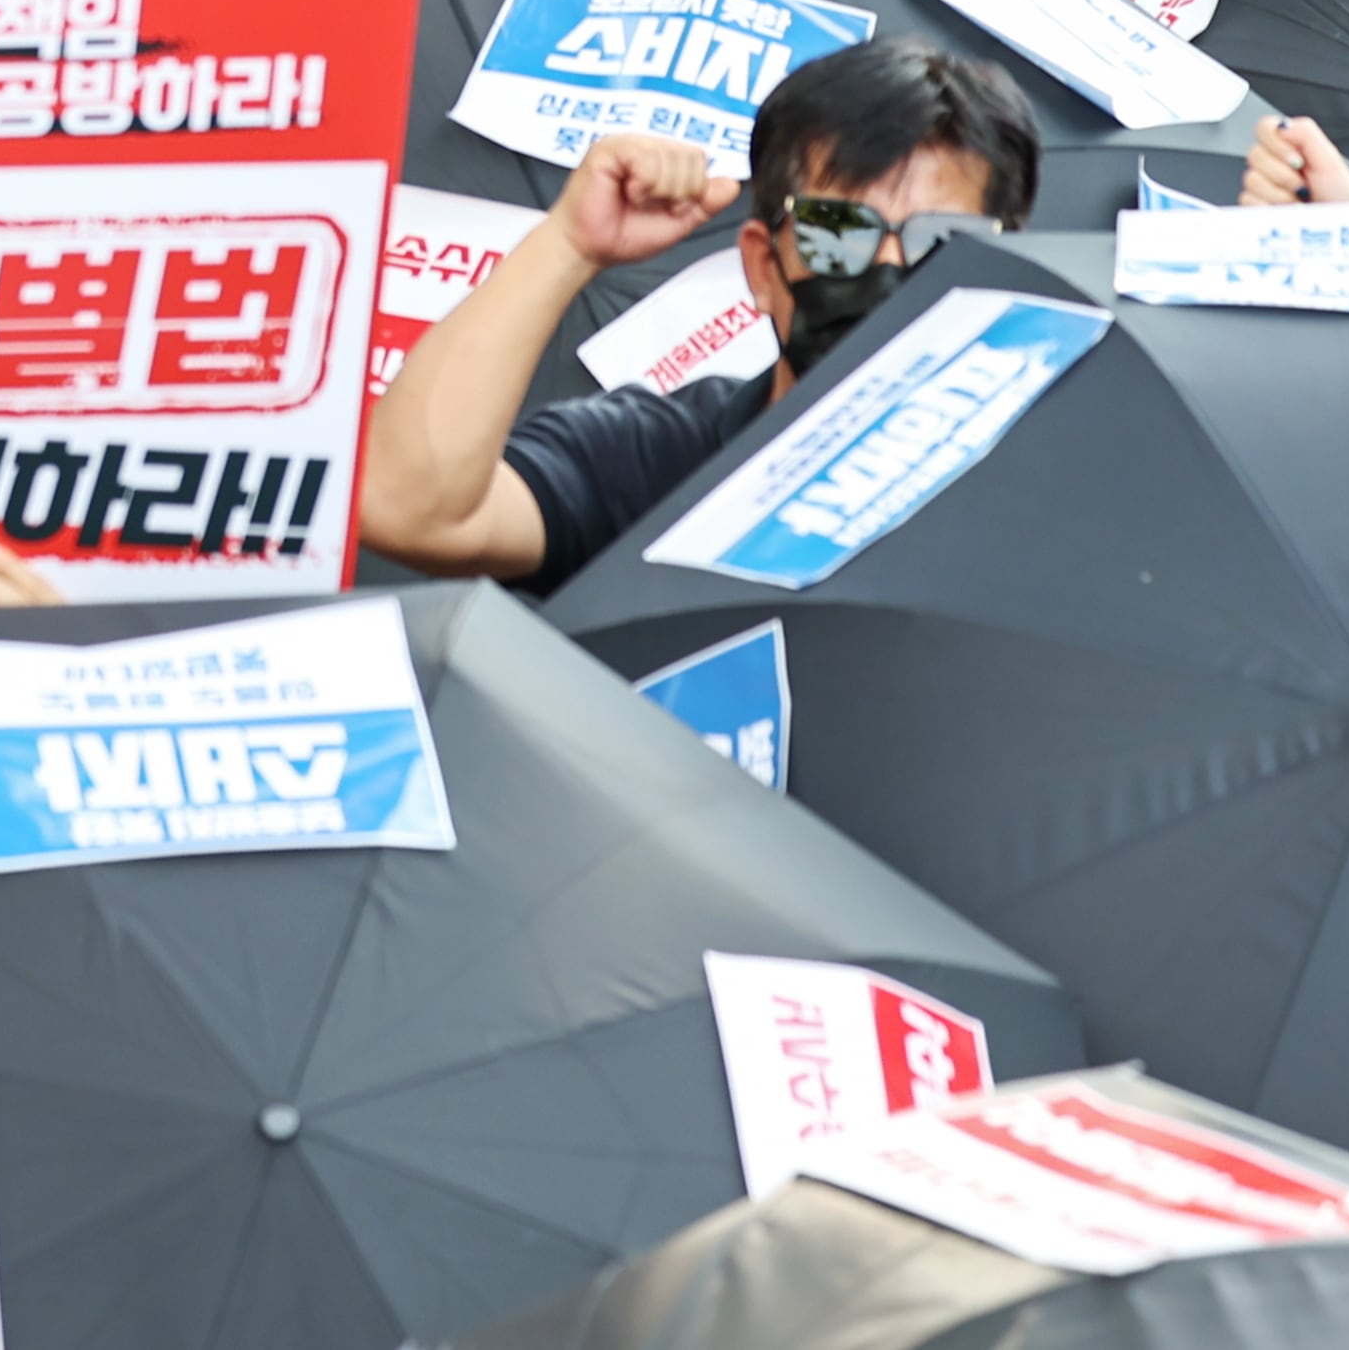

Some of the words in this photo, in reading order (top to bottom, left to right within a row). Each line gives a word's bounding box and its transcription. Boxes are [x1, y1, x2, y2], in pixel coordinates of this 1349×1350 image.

[544, 15, 795, 110] 소비자
[536, 92, 640, 129] 상품도
[650, 107, 754, 147] 환불도
[644, 299, 765, 396] 계획범죄
[30, 722, 349, 813] 소비자
